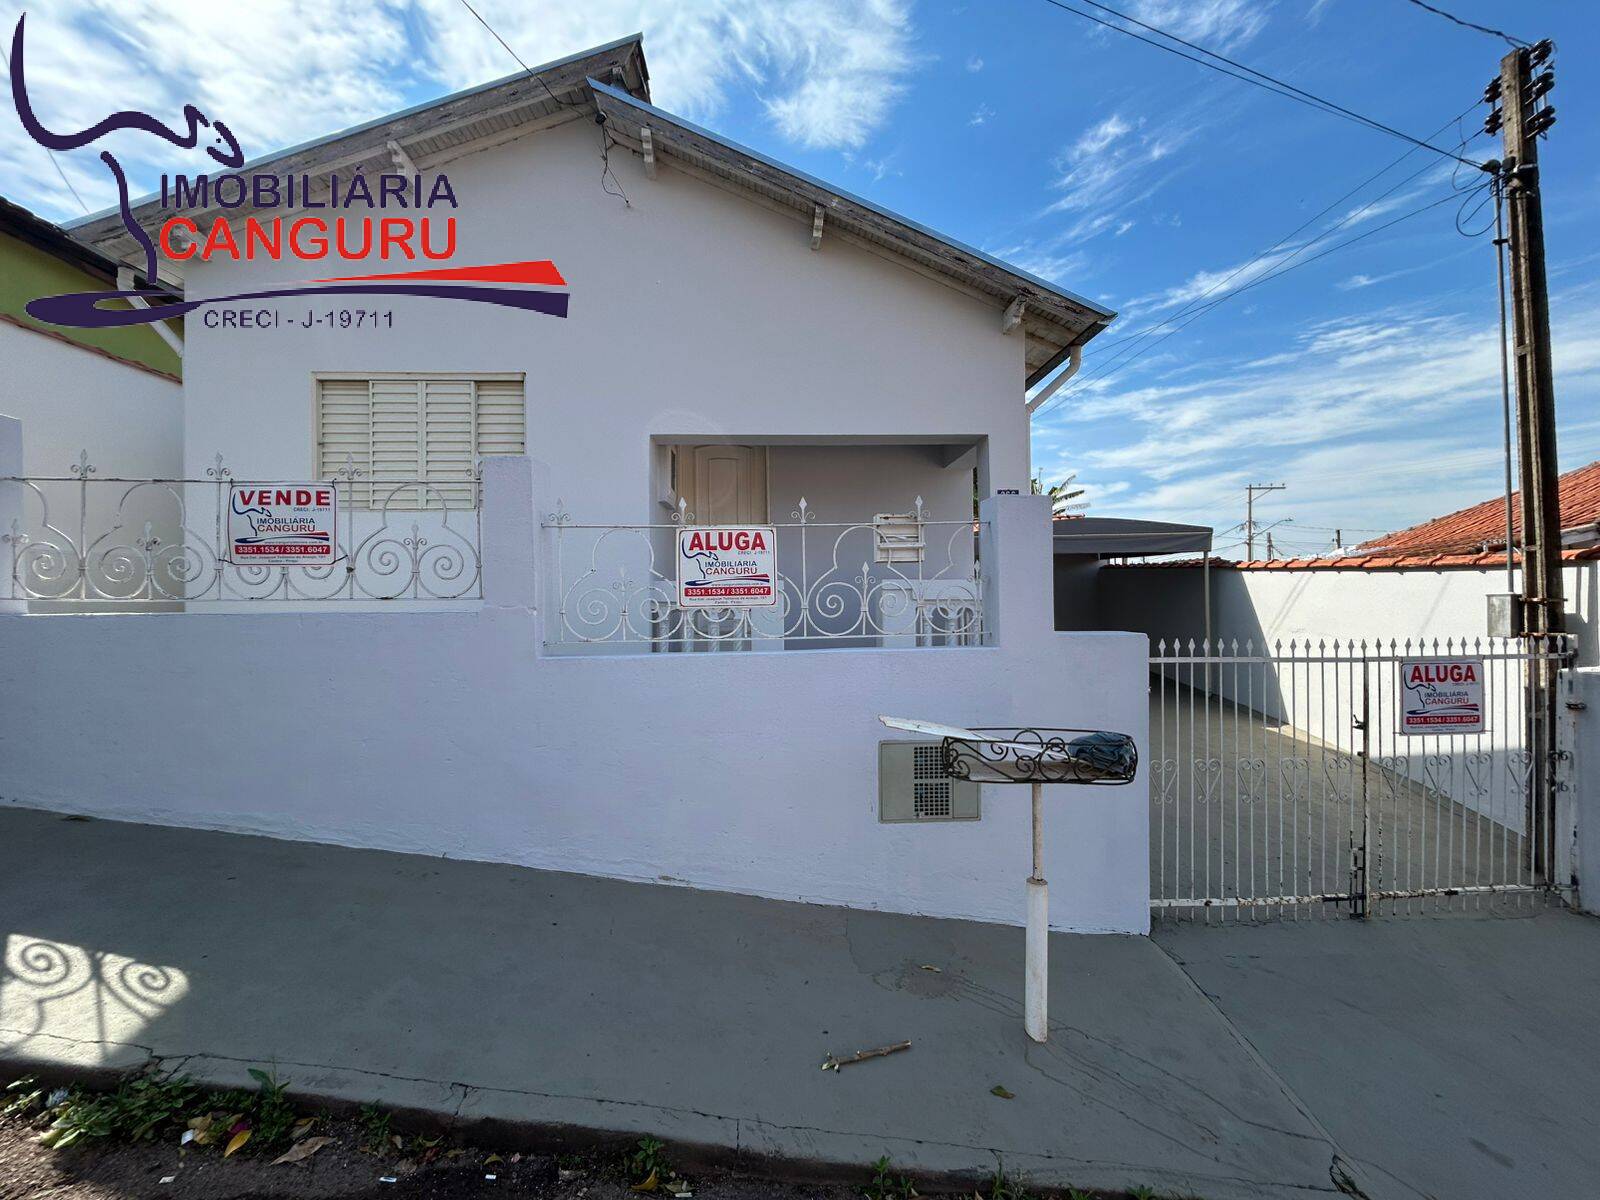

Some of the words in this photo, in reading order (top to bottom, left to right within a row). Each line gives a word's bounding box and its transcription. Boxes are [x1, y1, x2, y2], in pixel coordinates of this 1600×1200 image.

[240, 490, 330, 506] VENDE
[689, 532, 766, 551] ALUGA
[705, 567, 758, 575] CANGURU
[731, 587, 768, 595] 3351.6047
[1410, 664, 1476, 682] ALUGA
